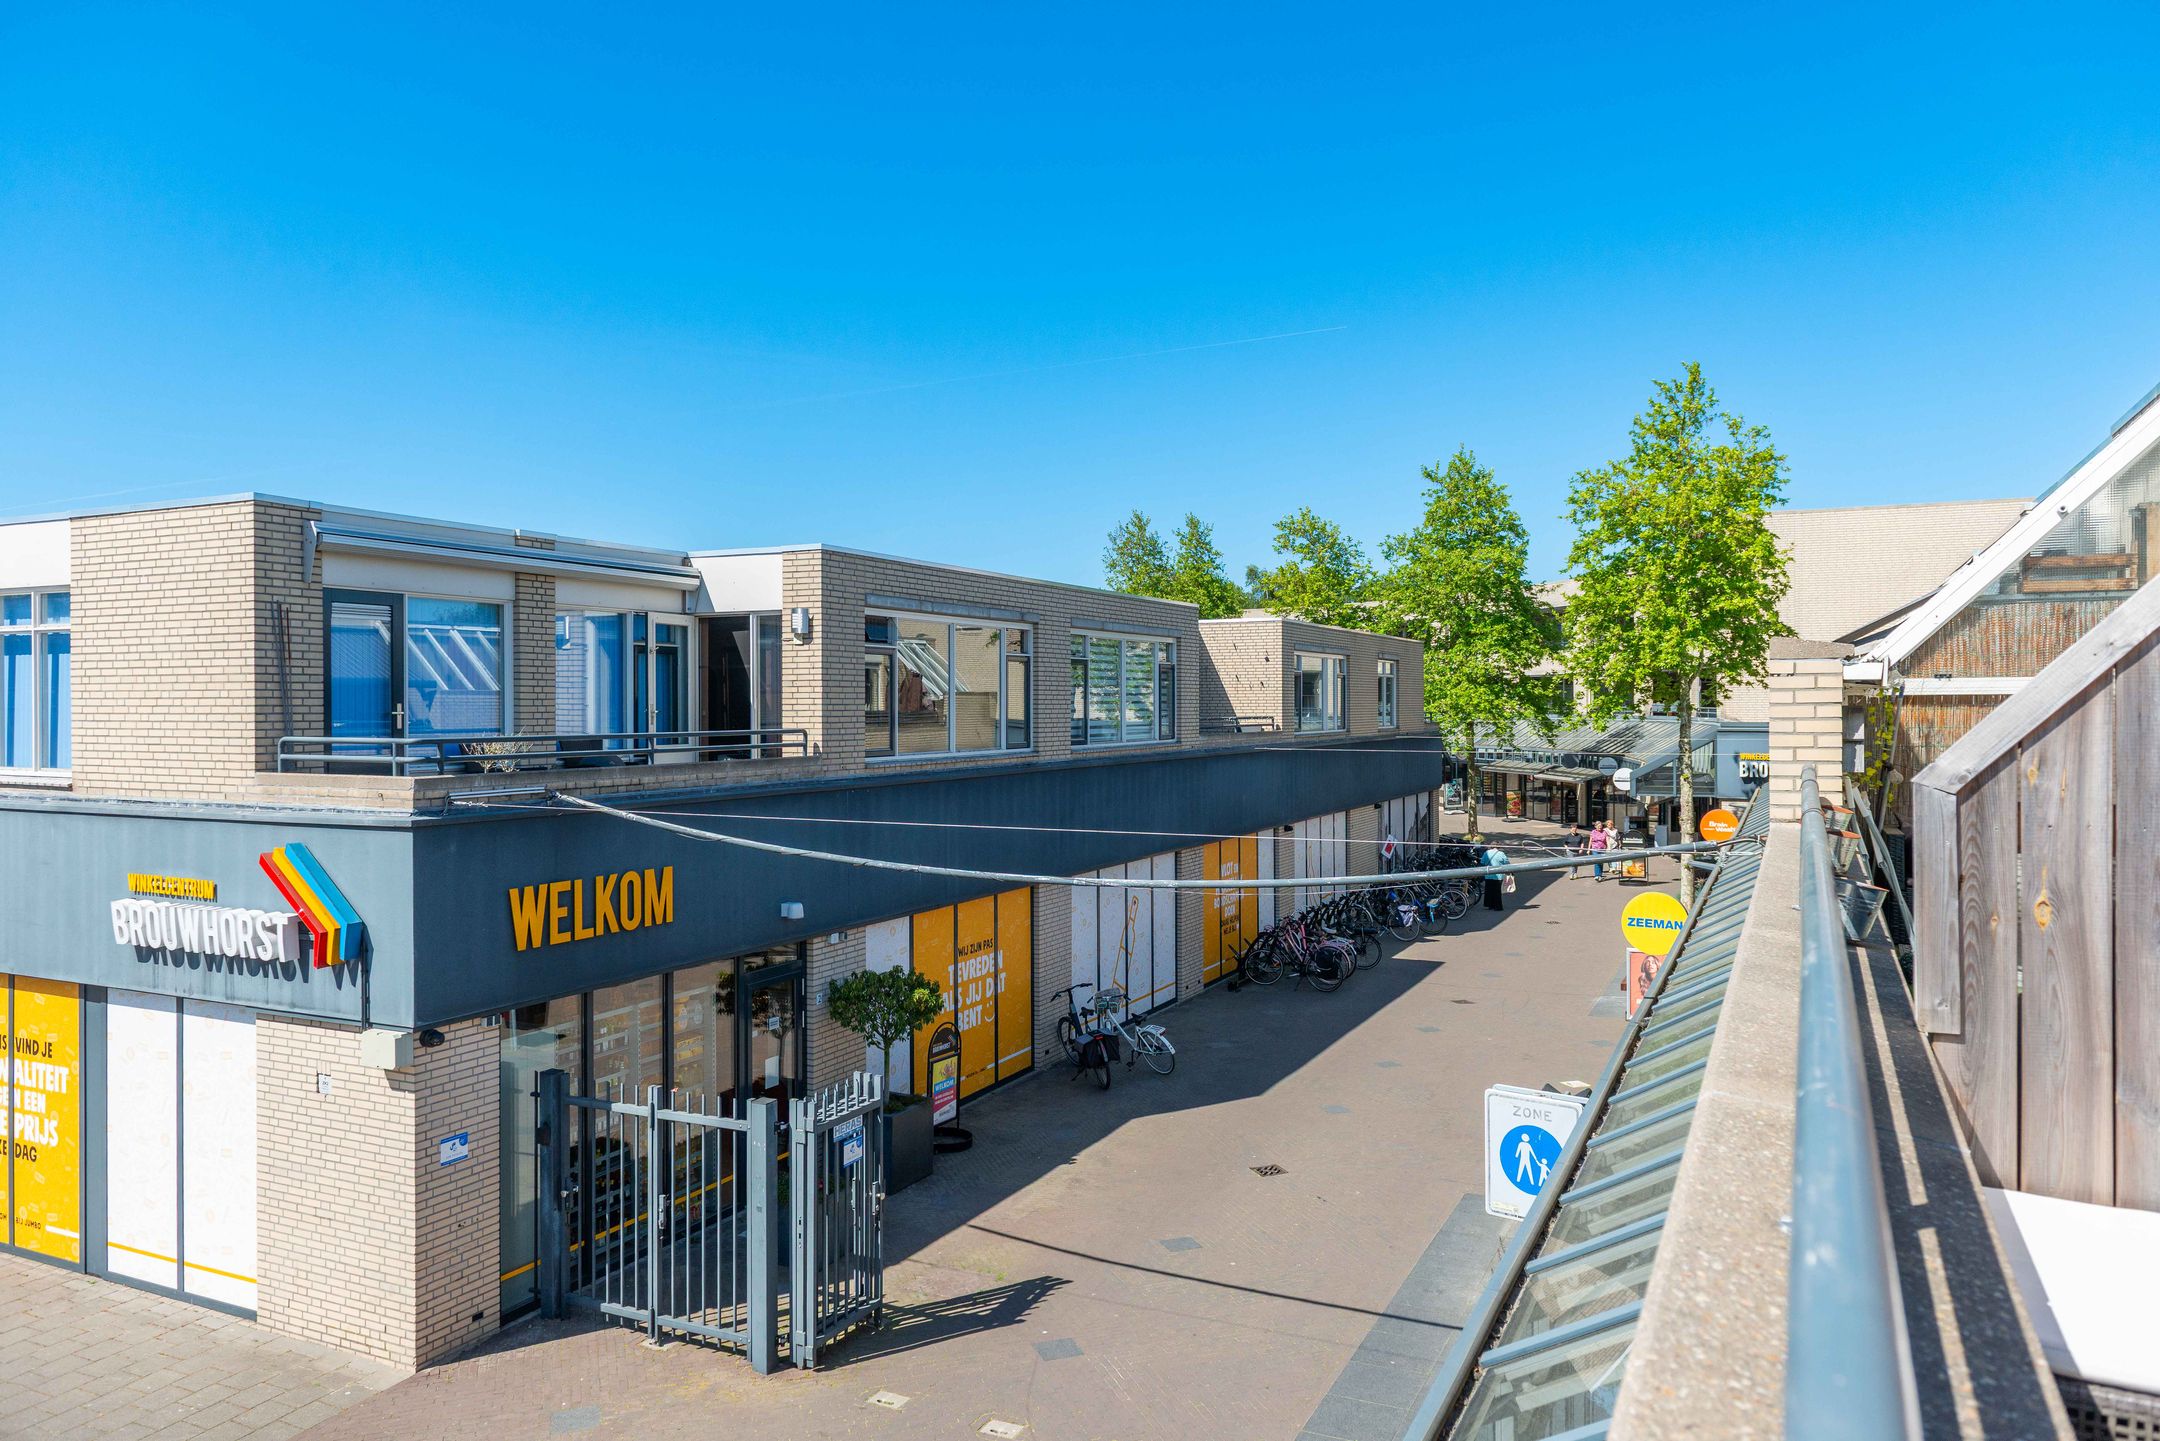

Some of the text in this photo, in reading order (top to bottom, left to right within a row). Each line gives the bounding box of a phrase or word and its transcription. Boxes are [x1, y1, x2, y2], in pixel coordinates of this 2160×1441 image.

[1739, 761, 1769, 778] BRO
[127, 873, 216, 900] WINKELCENTRUM
[509, 866, 673, 951] WELKOM
[111, 898, 292, 963] BROUWHORST
[1627, 917, 1683, 930] ZEEMAN
[958, 945, 969, 957] WIJ
[983, 938, 993, 950] PAS
[948, 950, 1003, 986] TEVREDEN
[966, 981, 982, 1005] JIJ
[958, 1005, 983, 1033] BENT
[15, 1037, 40, 1056] VIND
[41, 1042, 52, 1058] JE
[24, 1090, 46, 1114] EEN
[1512, 1105, 1552, 1122] ZONE
[14, 1113, 59, 1148] PRIJS
[15, 1146, 37, 1163] DAG
